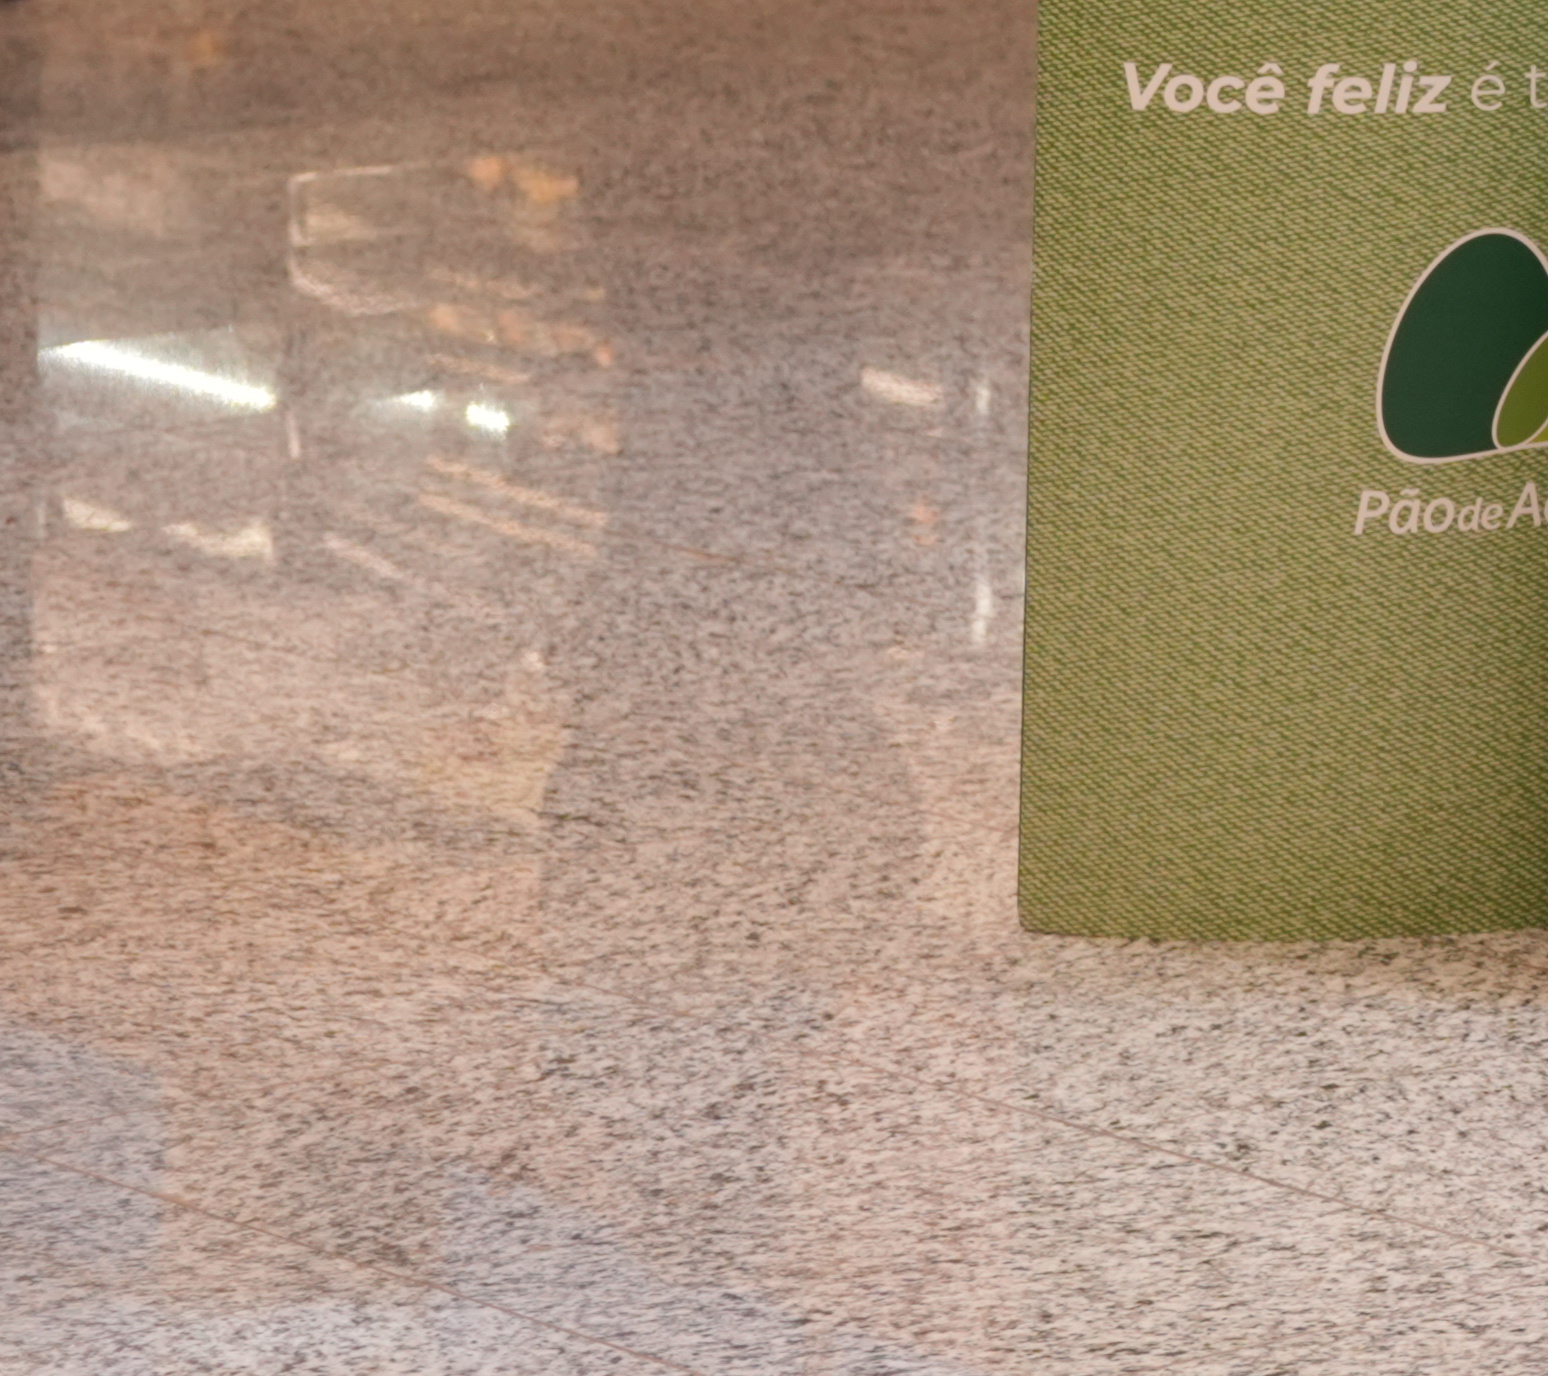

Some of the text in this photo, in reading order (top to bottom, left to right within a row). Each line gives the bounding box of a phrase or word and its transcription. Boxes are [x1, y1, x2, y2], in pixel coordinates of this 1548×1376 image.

[1123, 61, 1286, 114] Você
[1307, 59, 1451, 115] feliz
[1470, 66, 1506, 112] é
